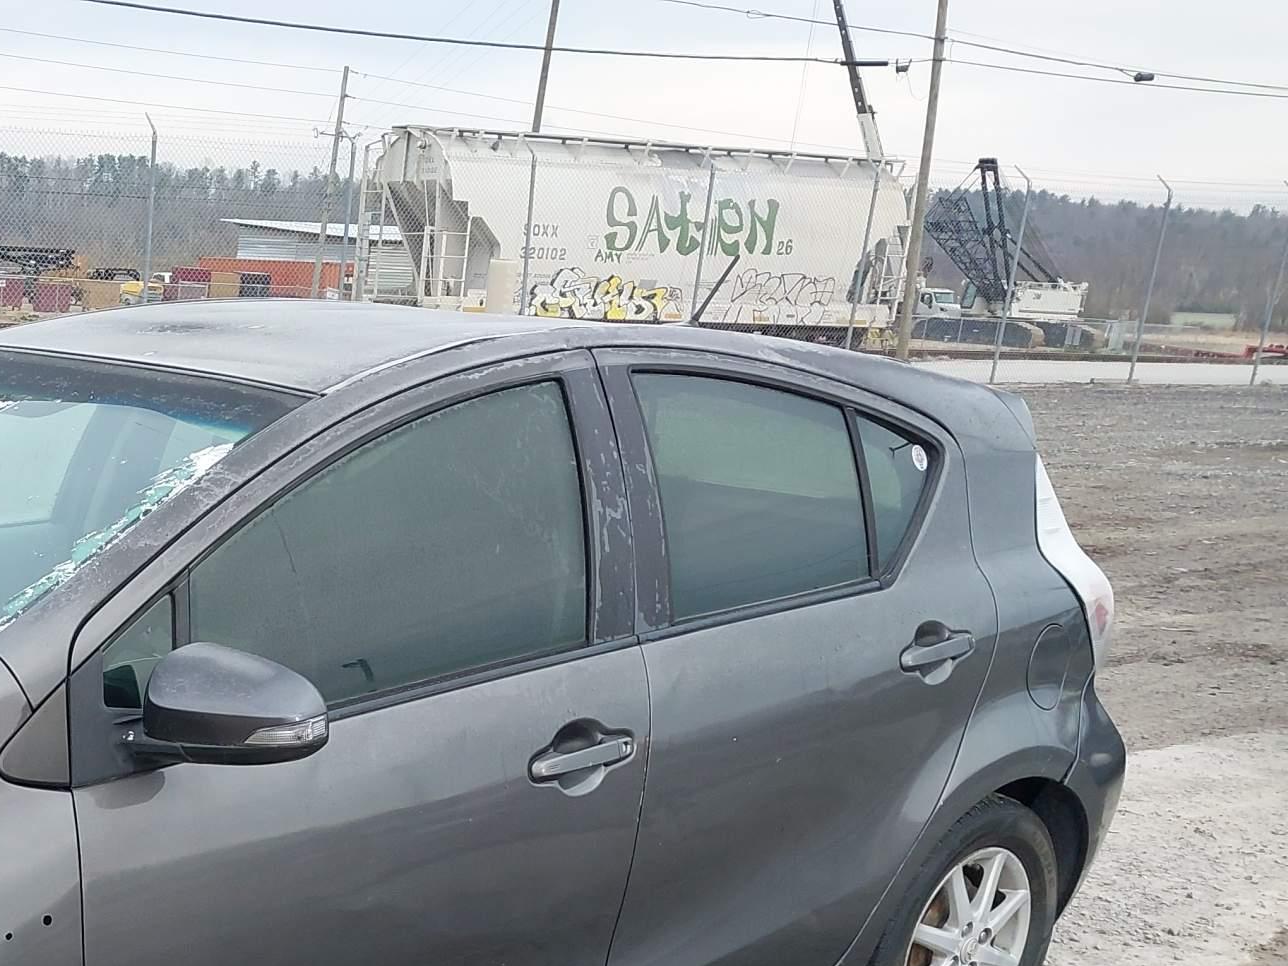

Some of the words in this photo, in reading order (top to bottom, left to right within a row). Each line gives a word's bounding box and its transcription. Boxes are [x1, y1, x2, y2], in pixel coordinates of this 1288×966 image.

[519, 246, 567, 260] 320102
[776, 239, 793, 256] 26
[594, 248, 623, 263] AMY
